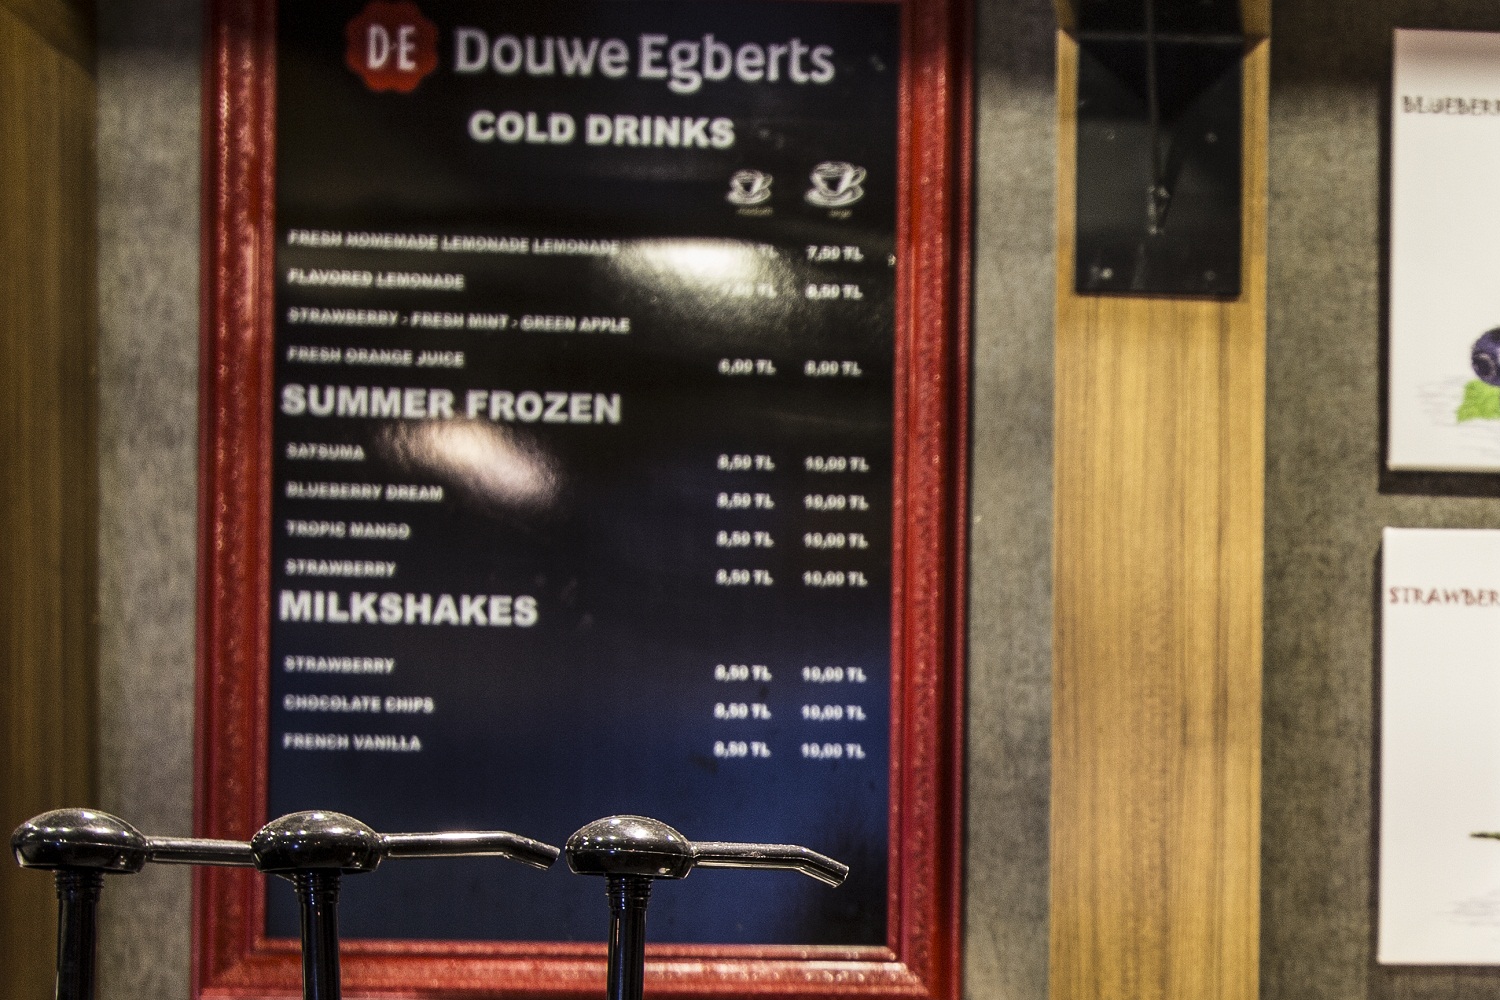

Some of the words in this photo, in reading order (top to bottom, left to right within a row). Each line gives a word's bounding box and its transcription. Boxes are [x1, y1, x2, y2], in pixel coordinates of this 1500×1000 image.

[454, 27, 629, 76] Douwe
[637, 33, 836, 94] Egberts
[468, 110, 575, 143] COLD
[585, 114, 736, 149] DRINKS
[287, 229, 342, 247] FRESH
[346, 231, 438, 250] HOMEMADE
[441, 234, 530, 253] LEMONADE
[532, 237, 620, 256] LEMONADE
[287, 268, 373, 287] FLAVORED
[376, 271, 465, 290] LEMONADE
[287, 306, 399, 327] STRAWBERRY
[410, 310, 464, 329] FRESH
[467, 312, 509, 331] MINT
[520, 314, 576, 333] GREEN
[578, 316, 631, 334] APPLE
[287, 345, 341, 363] FRESH
[345, 347, 412, 366] ORANGE
[416, 350, 465, 368] JUICE
[281, 385, 454, 421] SUMMER
[466, 390, 622, 425] FROZEN
[286, 442, 365, 461] SATSUMA
[286, 480, 382, 500] BLUEBERRY
[385, 484, 444, 503] DREAM
[286, 518, 346, 538] TROPIC
[350, 521, 410, 540] MANGO
[285, 557, 396, 578] STRAWBERRY
[280, 589, 538, 626] MILKSHAKES
[283, 654, 395, 674] STRAWBERRY
[283, 693, 382, 713] CHOCOLATE
[384, 695, 434, 714] CHIPS
[282, 731, 349, 751] FRENCH
[352, 733, 422, 753] VANILLA
